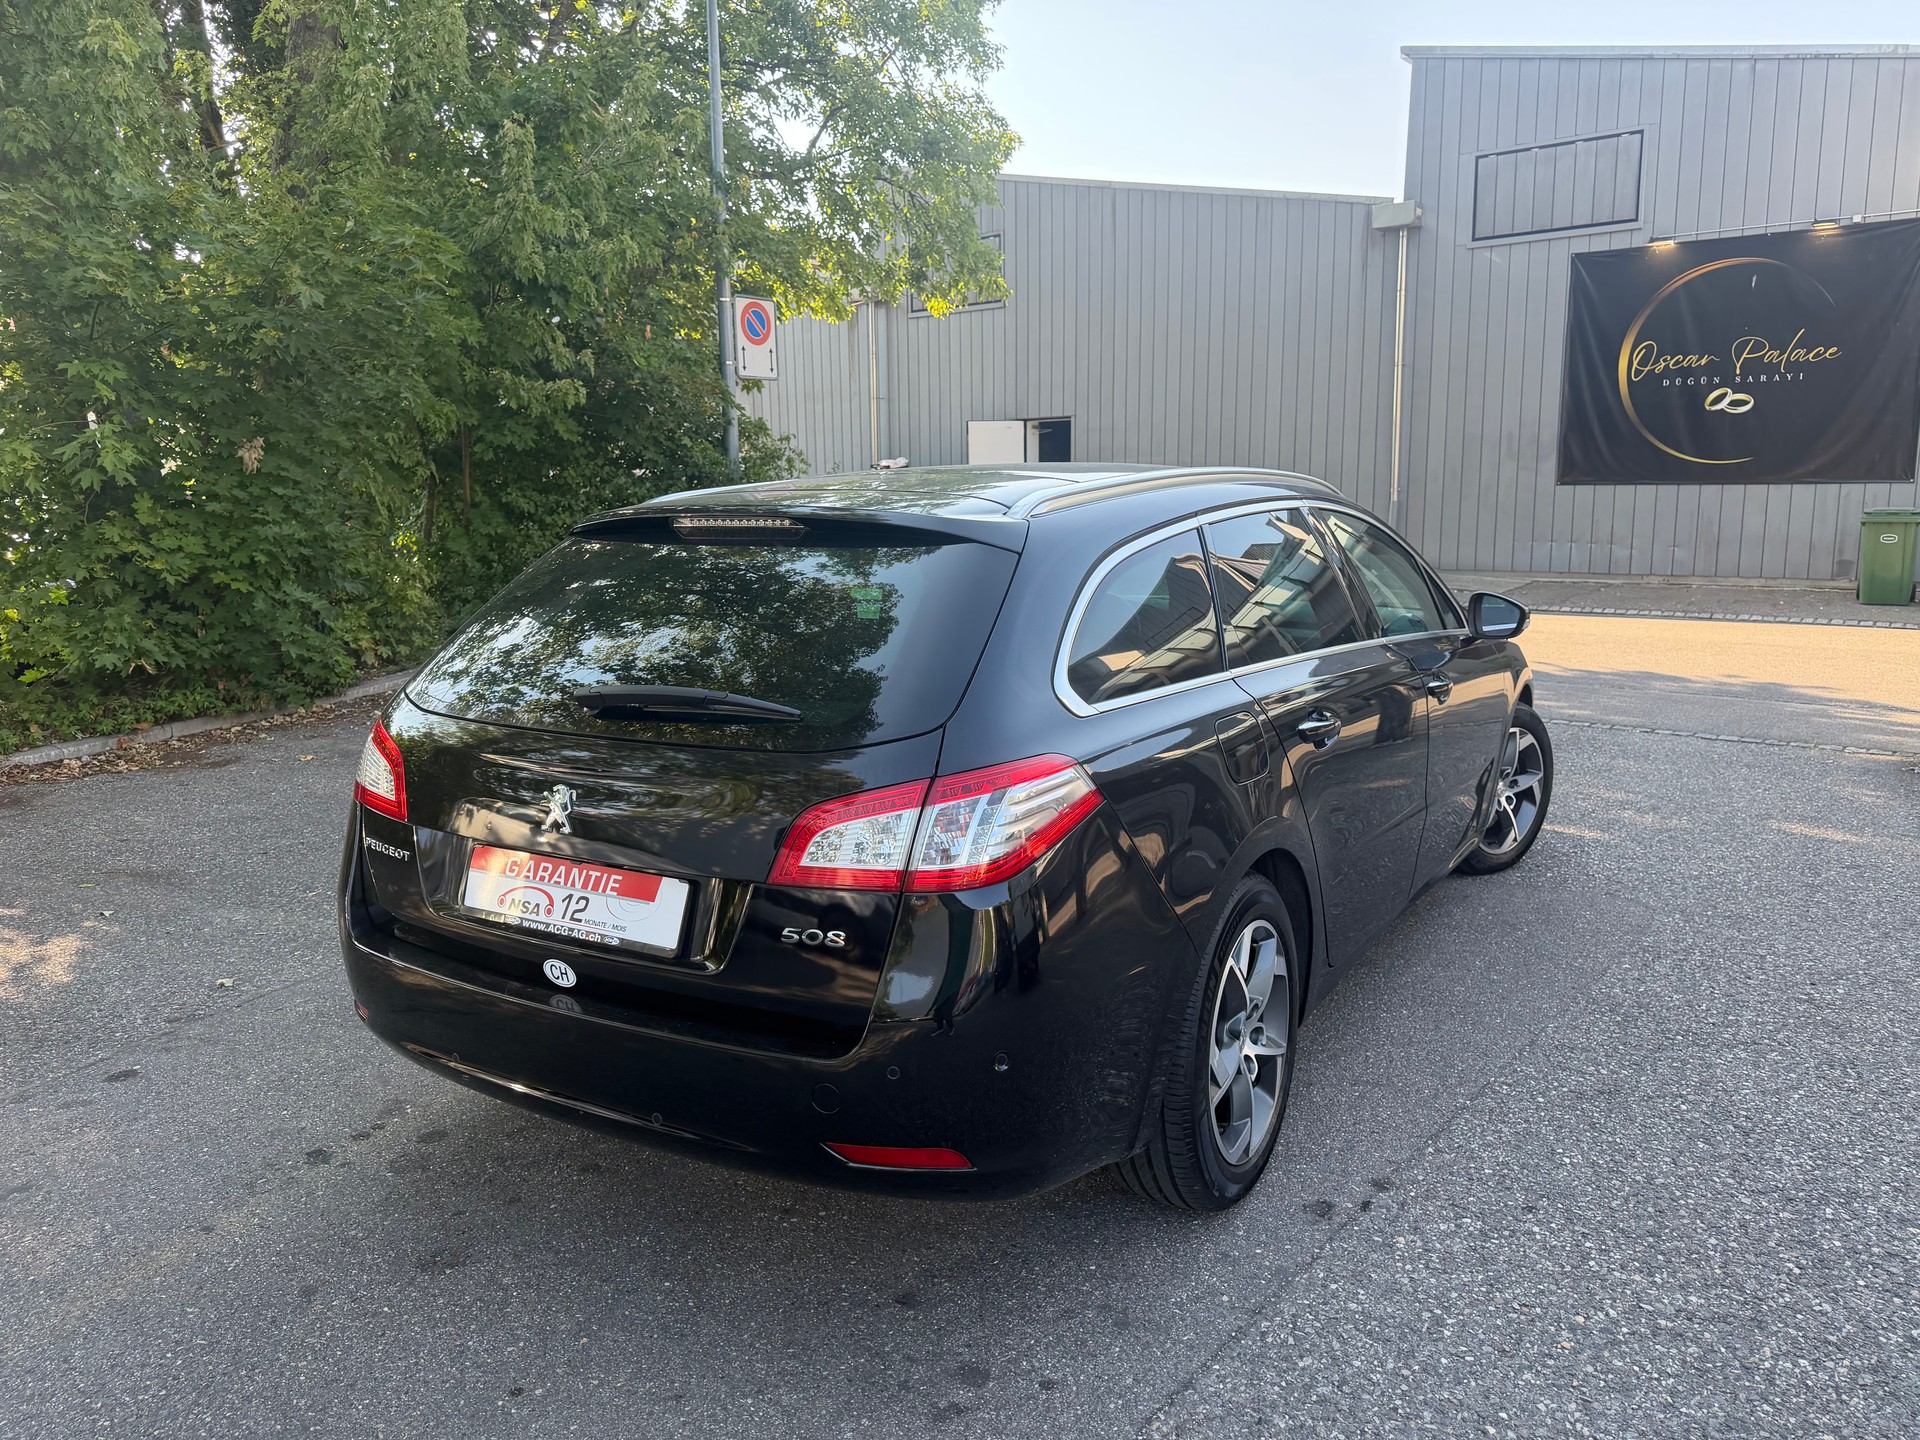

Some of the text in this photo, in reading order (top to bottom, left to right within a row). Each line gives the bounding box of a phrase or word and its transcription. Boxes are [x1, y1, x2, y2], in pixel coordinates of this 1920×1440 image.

[1631, 328, 1843, 382] Oscar Palace
[1735, 372, 1804, 383] SARAYI
[365, 836, 410, 861] PEUGEOT
[505, 857, 623, 896] GARANTIE
[507, 897, 541, 917] NSA
[561, 893, 590, 924] 12
[584, 918, 608, 929] MONATE
[612, 924, 628, 932] MOIS
[522, 919, 601, 942] www.ACG-AG.ch
[781, 927, 846, 948] 508
[550, 963, 570, 983] CH
